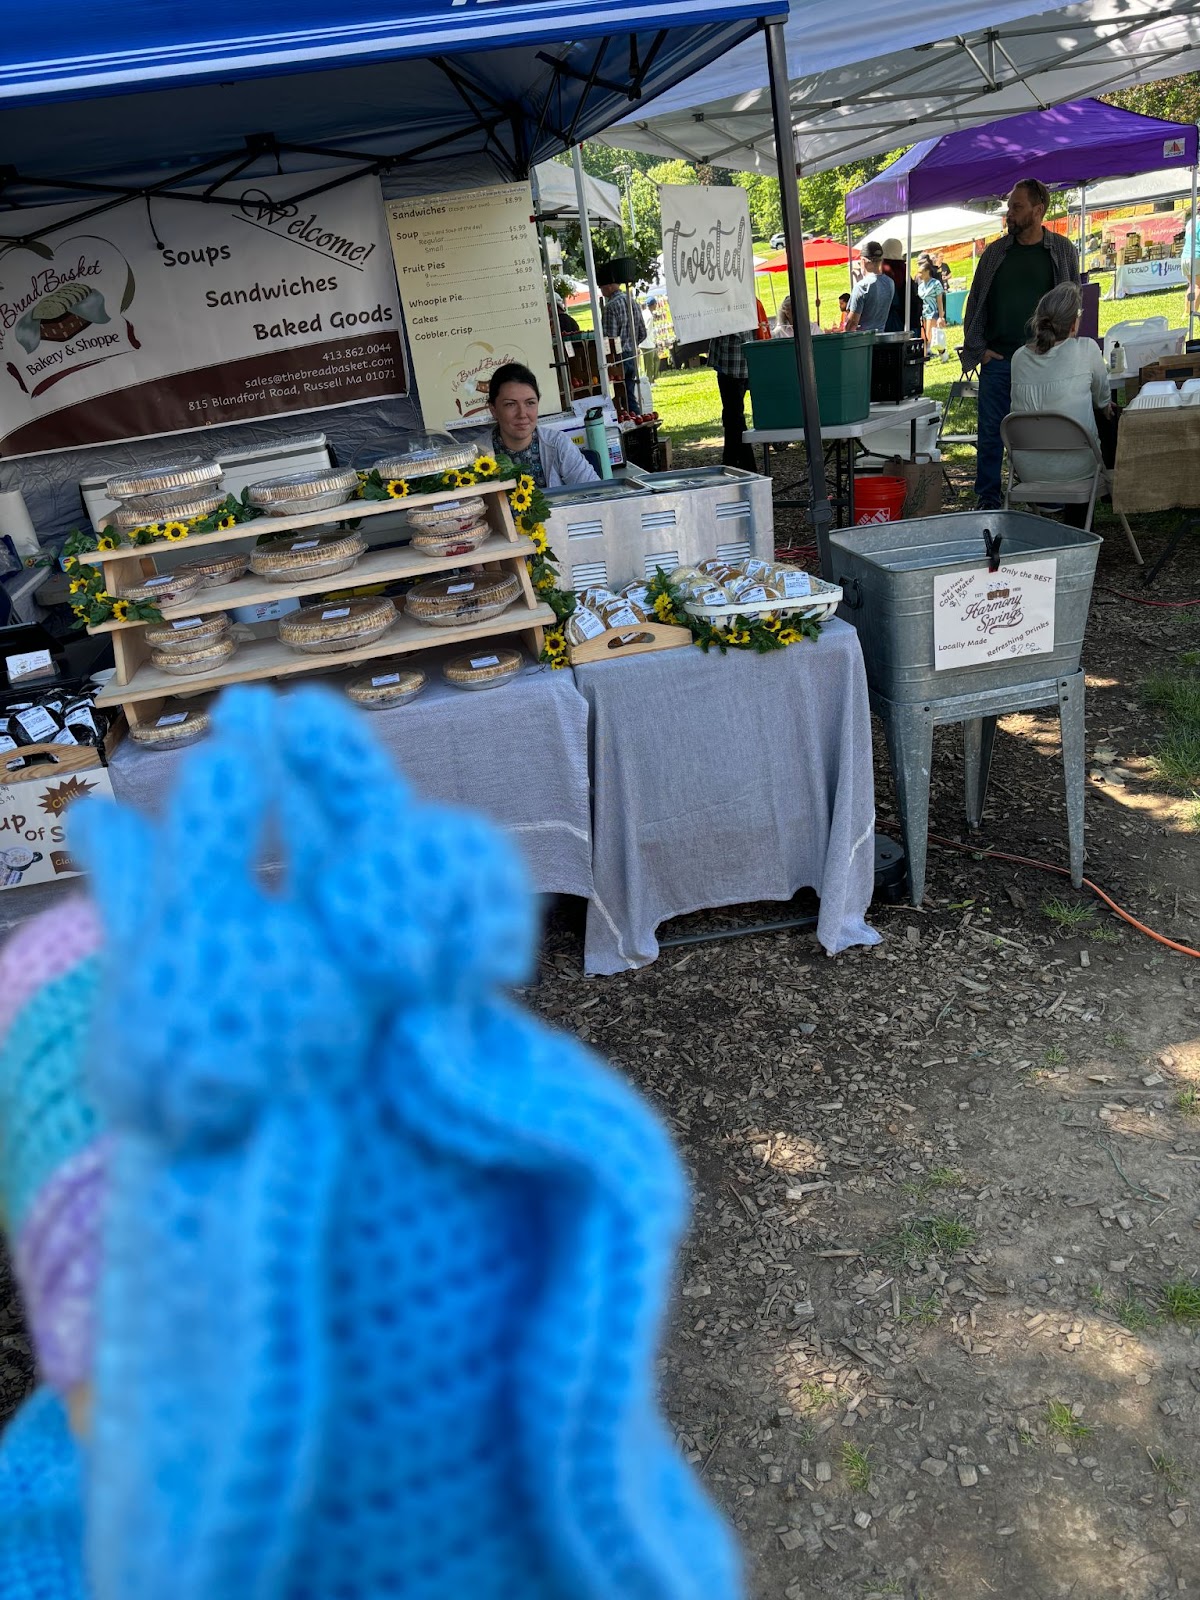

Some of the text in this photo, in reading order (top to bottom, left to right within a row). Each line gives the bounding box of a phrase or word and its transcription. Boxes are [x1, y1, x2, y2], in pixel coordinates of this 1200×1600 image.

[392, 206, 446, 220] Sandwiches
[240, 188, 376, 265] Welcome!
[396, 231, 419, 241] Soup
[418, 224, 526, 246] Regular $5.99
[424, 233, 527, 253] Small $4.99
[664, 216, 745, 286] twisted
[162, 245, 231, 267] Soups
[402, 261, 446, 274] Fruit Pies
[0, 255, 102, 328] Bread Basket
[205, 275, 338, 308] Sandwiches
[408, 284, 536, 308] Whoopie Pie $2.75
[253, 304, 393, 340] Baked Goods
[412, 301, 538, 325] Cakes $3.99
[414, 330, 449, 341] Cobbler,
[450, 326, 473, 336] Crisp
[26, 333, 120, 376] Bakery & Shoppe
[322, 343, 392, 361] 413.862.0044
[244, 357, 394, 388] sales@thebreadbasket.com
[188, 369, 396, 411] 815 Blandford Road, Russell Ma 01071
[941, 577, 963, 597] We Have
[1001, 567, 1052, 583] Only the BEST
[940, 575, 975, 607] Cold Water
[961, 594, 1023, 621] Harmony
[977, 607, 1025, 634] Springs
[938, 638, 988, 651] Locally Made
[986, 621, 1050, 658] Refreshing Drinks
[52, 787, 80, 808] Chili
[0, 814, 26, 834] up
[25, 826, 46, 841] of
